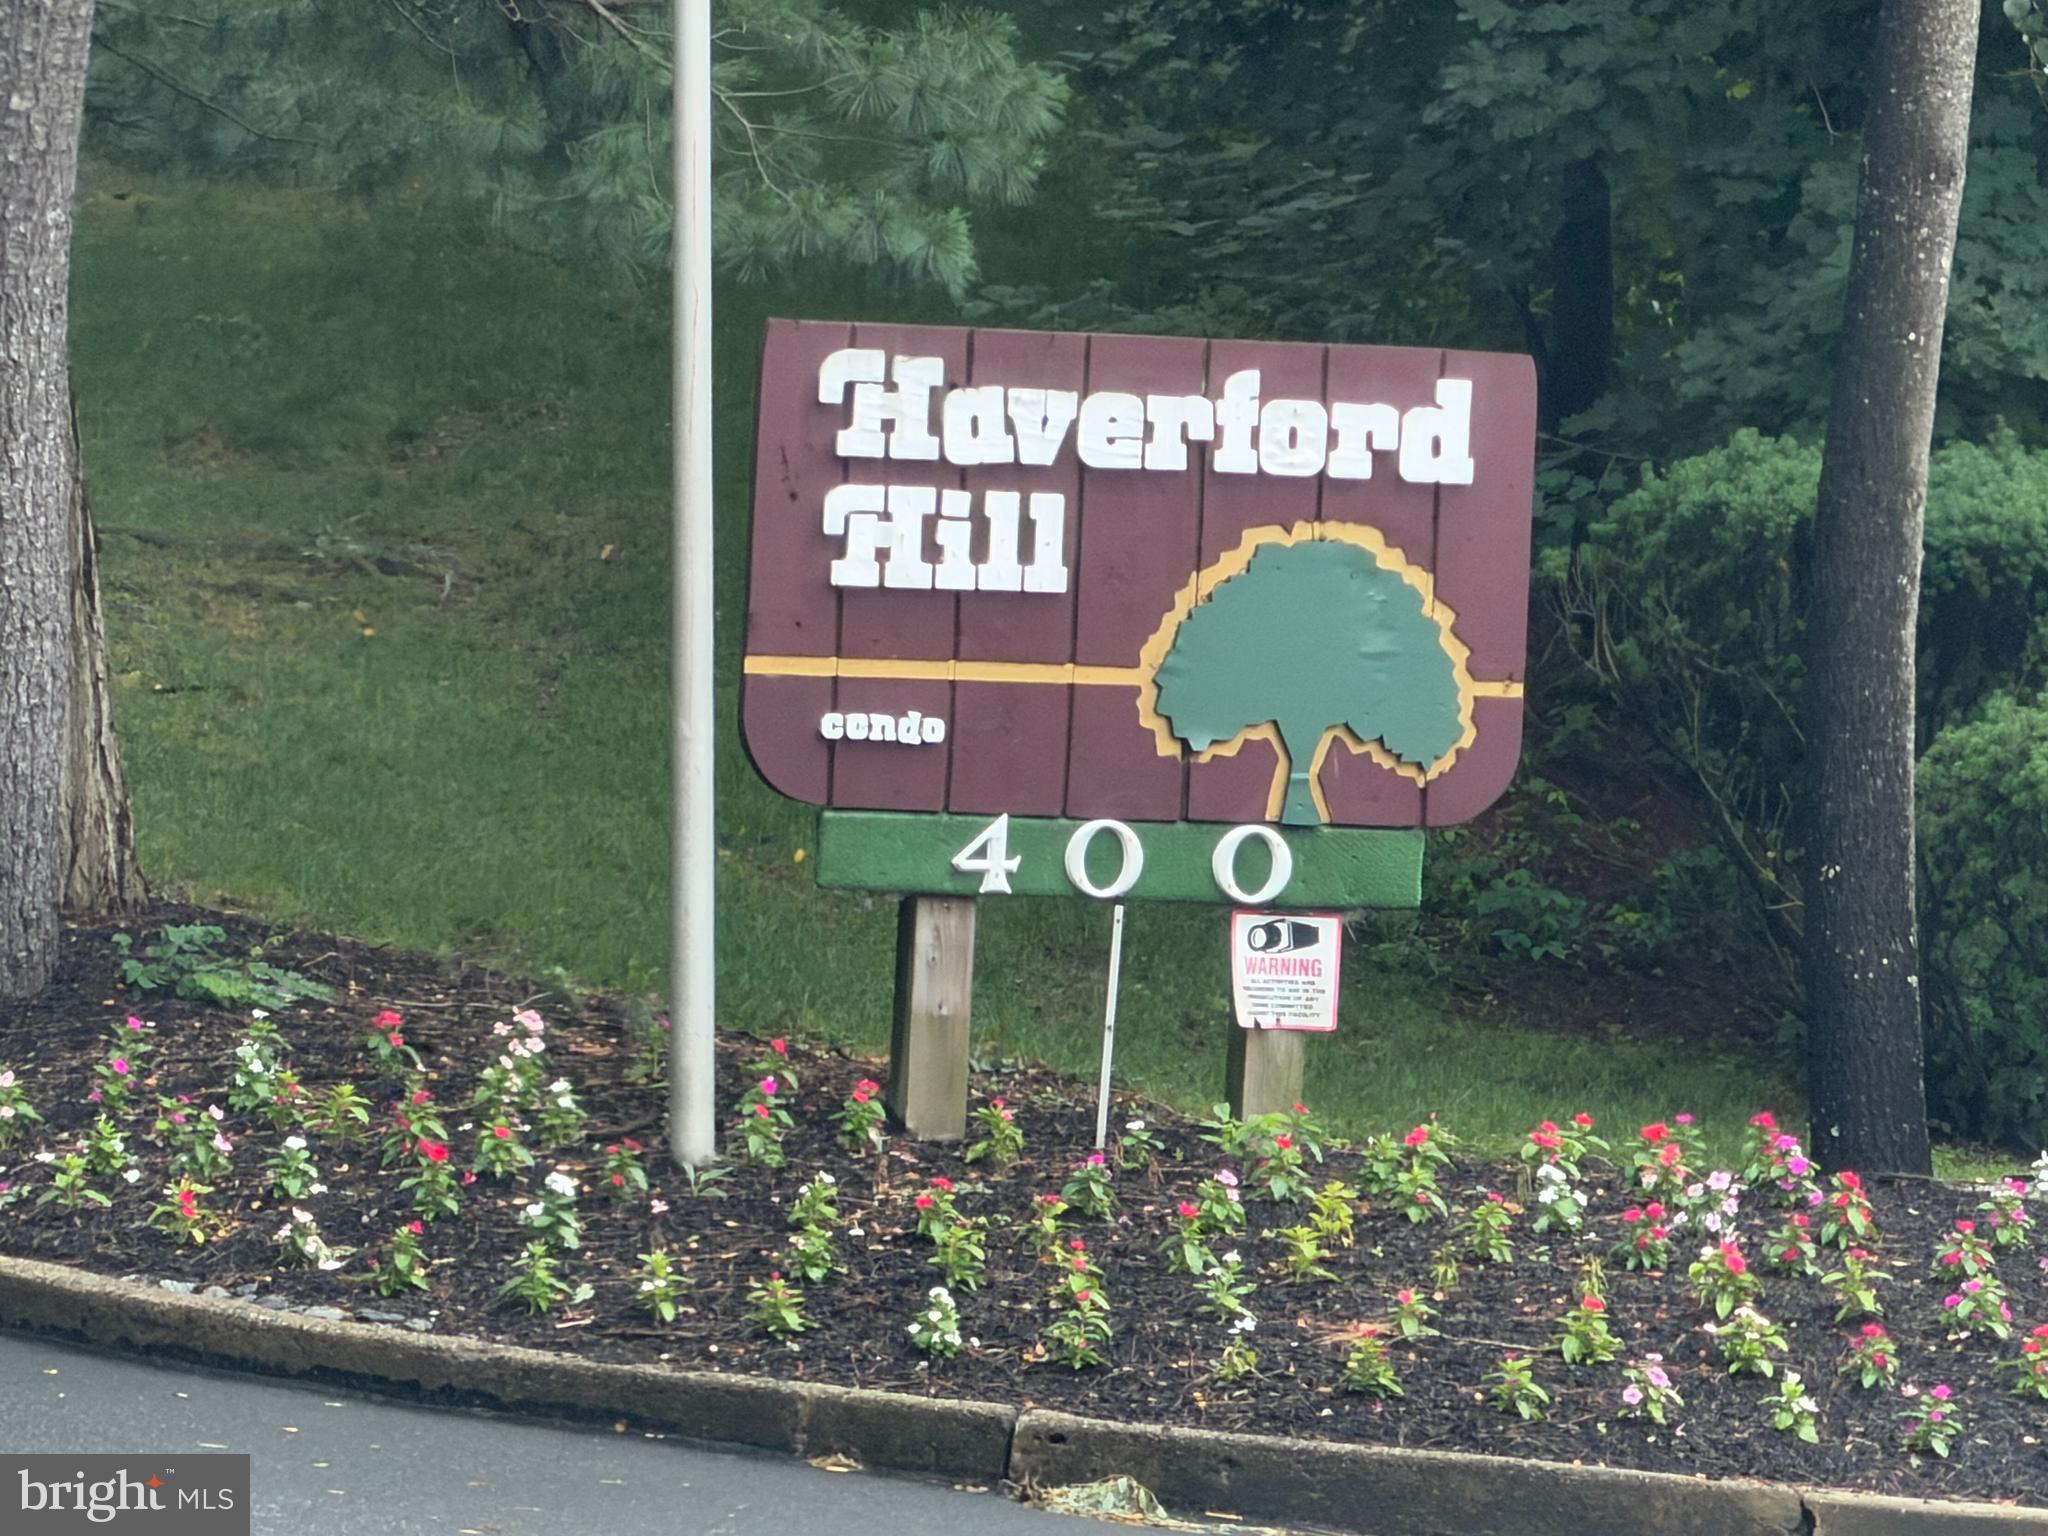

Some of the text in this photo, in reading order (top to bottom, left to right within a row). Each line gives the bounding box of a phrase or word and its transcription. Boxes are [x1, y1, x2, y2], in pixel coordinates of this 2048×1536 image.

[819, 348, 1474, 485] Haverford
[823, 484, 1067, 593] Hill
[821, 711, 946, 746] condo
[951, 813, 1293, 903] 400
[1244, 956, 1324, 978] WARNING
